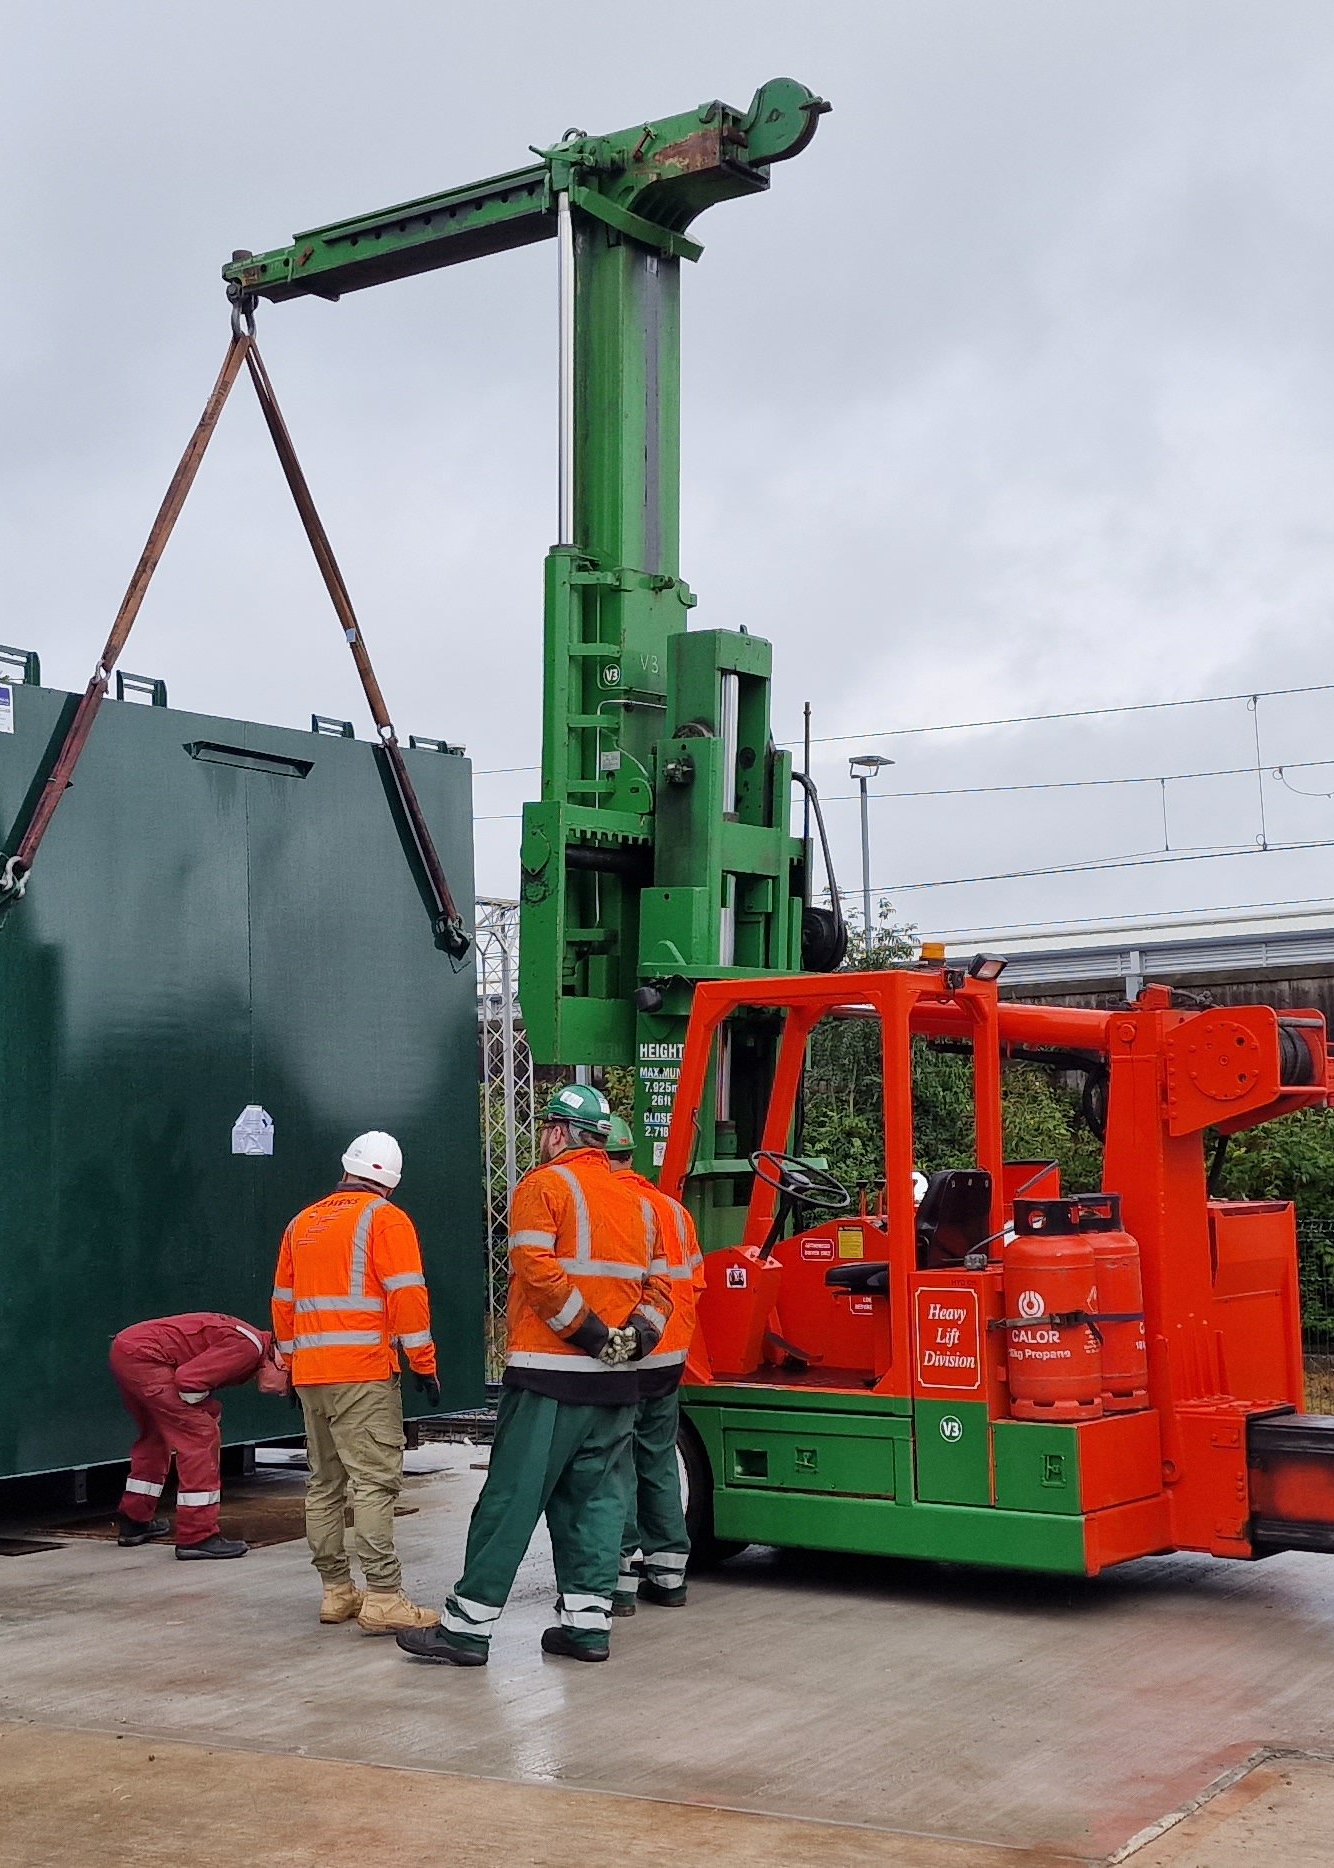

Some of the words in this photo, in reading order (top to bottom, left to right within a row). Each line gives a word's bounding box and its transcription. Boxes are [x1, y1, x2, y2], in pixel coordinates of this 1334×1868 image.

[606, 669, 618, 681] V3
[639, 1043, 684, 1058] HEIGHT
[928, 1303, 967, 1325] Heavy
[936, 1327, 960, 1347] Lift
[1011, 1330, 1061, 1343] CALOR
[923, 1350, 976, 1369] Division
[1024, 1349, 1071, 1360] Propane
[943, 1421, 959, 1437] V3
